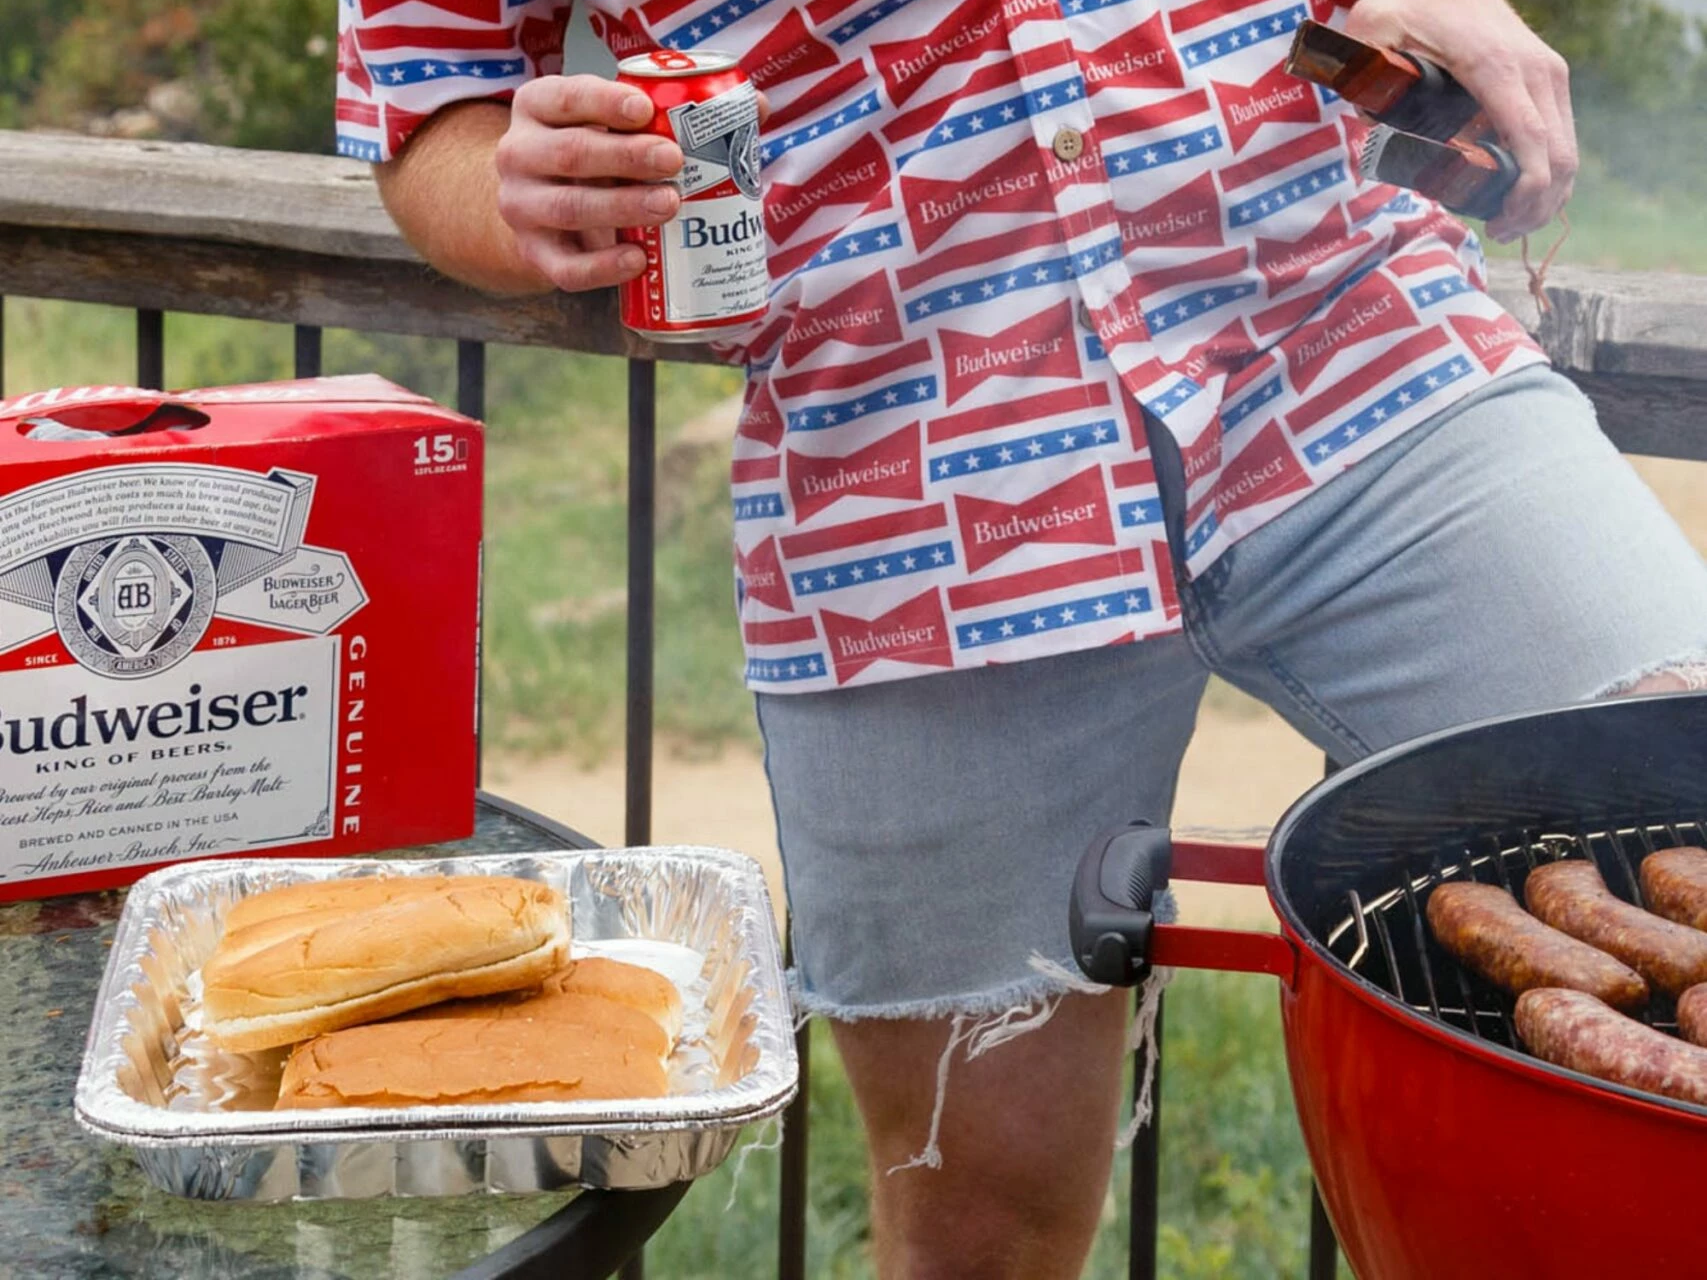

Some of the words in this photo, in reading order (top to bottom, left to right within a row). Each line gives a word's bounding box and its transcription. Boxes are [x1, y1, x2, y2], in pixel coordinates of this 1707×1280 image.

[890, 11, 999, 84] Budweiser
[1229, 81, 1305, 126] Budweiser
[768, 158, 878, 224] Budweiser
[918, 169, 1038, 225] Budweiser
[1296, 290, 1394, 365] Budweiser
[955, 335, 1064, 379] Budweiser
[414, 434, 455, 464] 15
[68, 482, 117, 499] Budweiser
[143, 477, 157, 486] We
[160, 477, 184, 486] know
[187, 478, 199, 488] of
[212, 480, 240, 493] brand
[802, 458, 911, 496] Budweiser
[22, 511, 47, 526] other
[50, 501, 81, 516] brewer
[85, 493, 112, 506] which
[115, 491, 140, 501] costs
[156, 489, 183, 498] much
[185, 490, 196, 499] to
[199, 491, 220, 502] brew
[222, 495, 242, 506] and
[128, 501, 174, 512] produces
[172, 515, 198, 524] other
[973, 500, 1098, 545] Budweiser
[25, 653, 58, 666] SINCE
[212, 636, 237, 646] 1876
[838, 622, 936, 658] Budweiser
[0, 684, 307, 754] udweiser
[343, 635, 367, 835] GENUINE
[36, 757, 96, 774] KING
[108, 752, 139, 765] OF
[49, 783, 68, 806] by
[70, 784, 95, 796] our
[99, 772, 158, 798] original
[159, 769, 207, 788] process
[209, 763, 246, 783] from
[249, 757, 271, 773] the
[75, 798, 113, 817] Rice
[115, 795, 148, 812] and
[149, 789, 187, 808] Best
[188, 785, 243, 804] Barley
[244, 776, 287, 797] Malt
[19, 834, 74, 849] BREWED
[78, 829, 105, 841] AND
[109, 821, 163, 837] CANNED
[167, 820, 181, 829] IN
[185, 816, 209, 827] THE
[213, 812, 239, 824] USA
